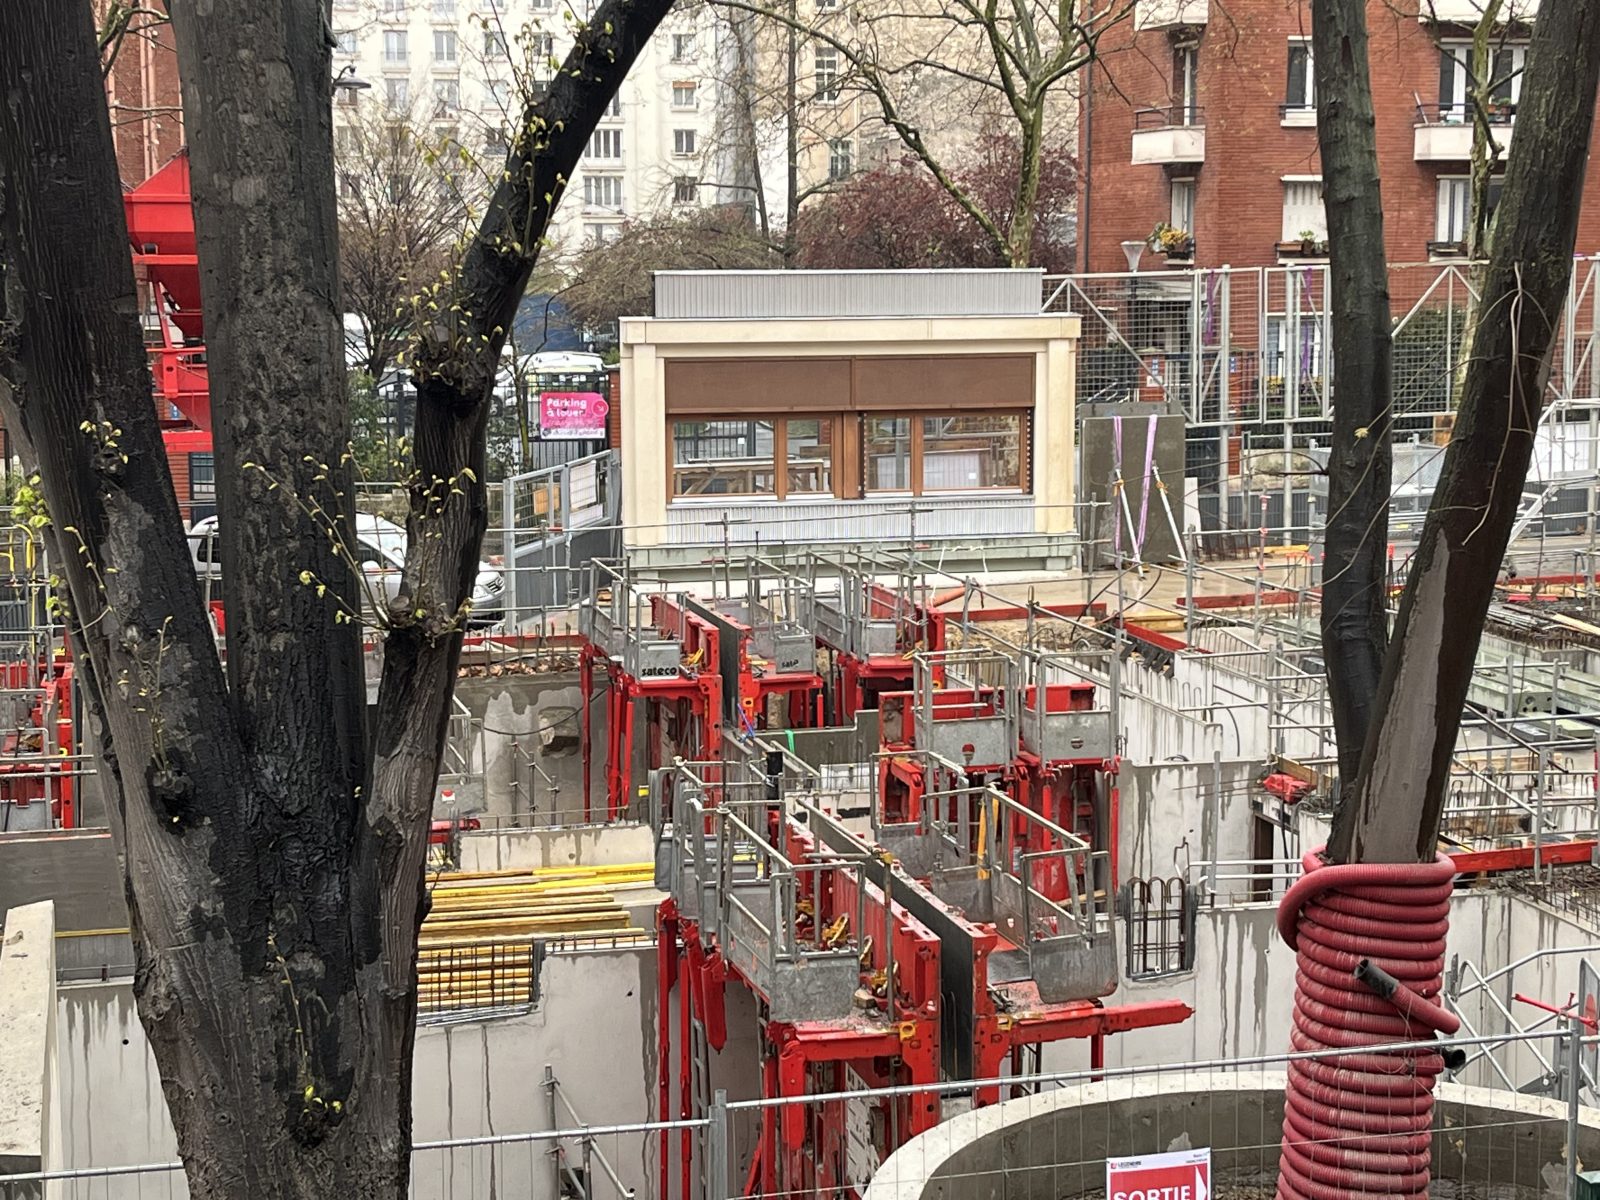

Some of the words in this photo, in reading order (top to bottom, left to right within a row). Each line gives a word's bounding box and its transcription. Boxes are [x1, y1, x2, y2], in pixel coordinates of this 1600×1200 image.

[547, 398, 587, 409] Parking
[557, 408, 583, 417] louer
[642, 667, 677, 676] sateco
